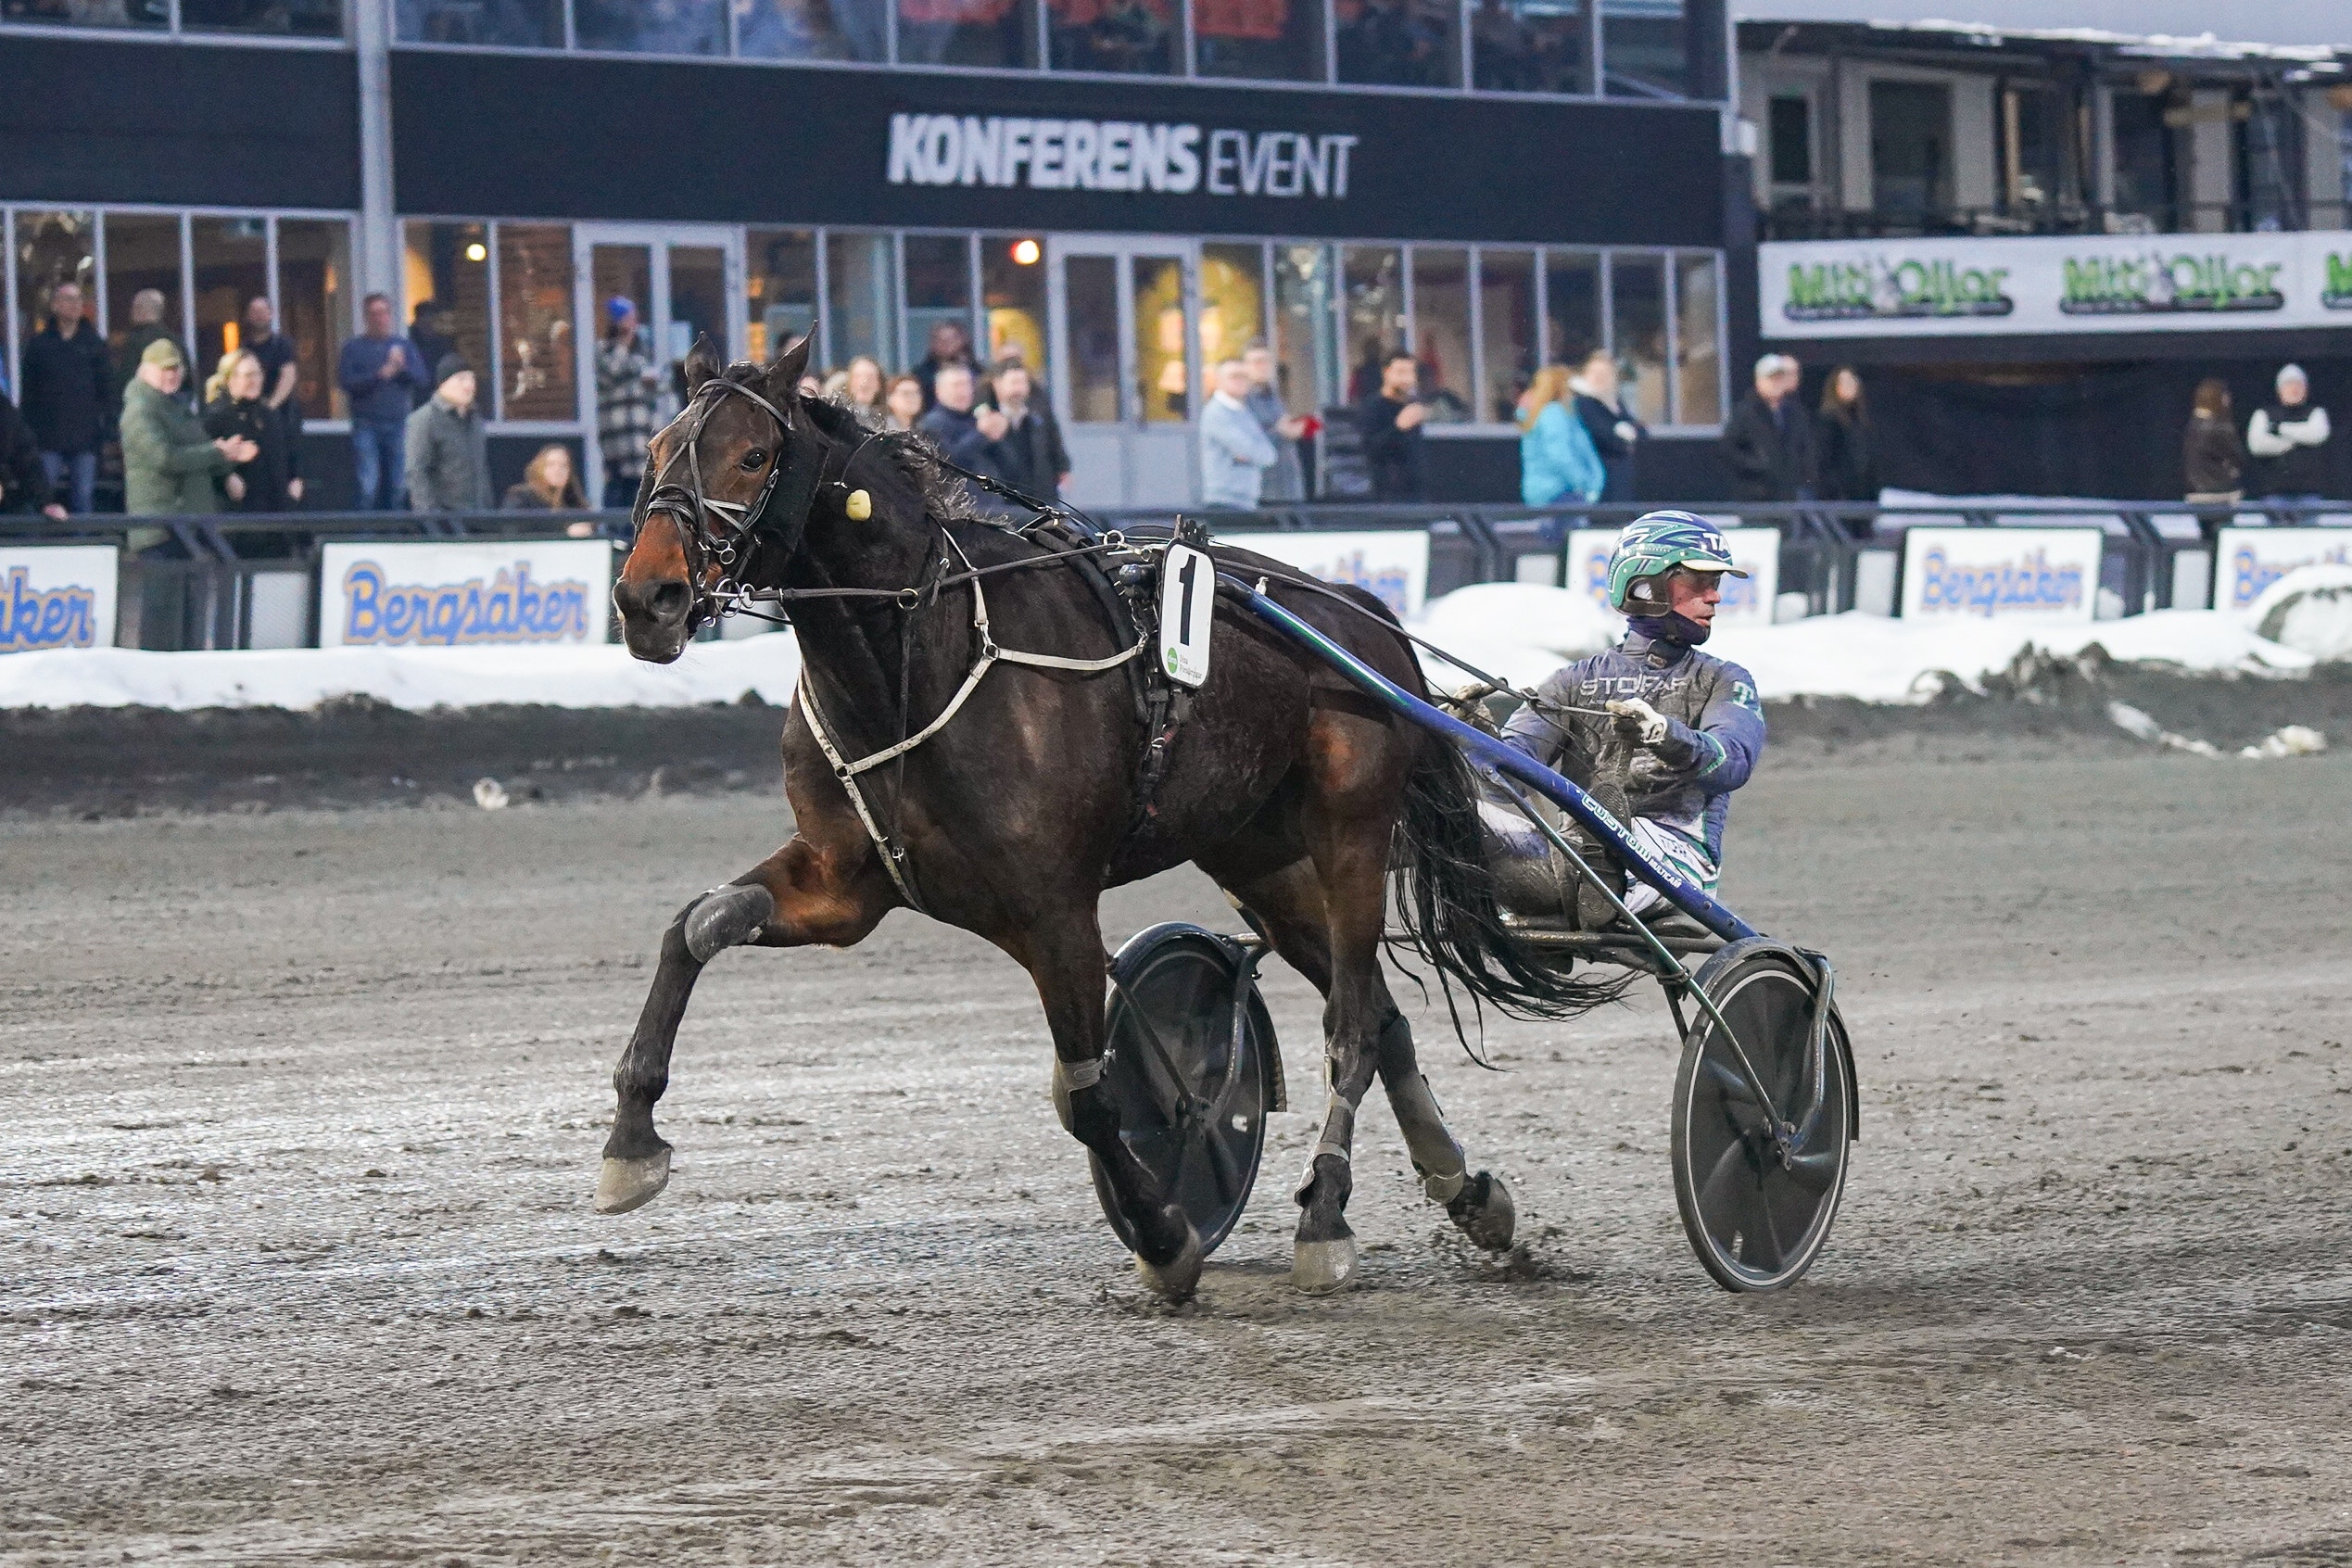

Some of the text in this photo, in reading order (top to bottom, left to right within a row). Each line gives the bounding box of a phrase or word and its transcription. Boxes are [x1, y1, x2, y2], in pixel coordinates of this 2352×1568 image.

[887, 112, 1359, 198] KONFERENS EVENT
[0, 565, 96, 654] ker
[1179, 553, 1197, 647] 1
[1581, 793, 1654, 863] CUSTOM
